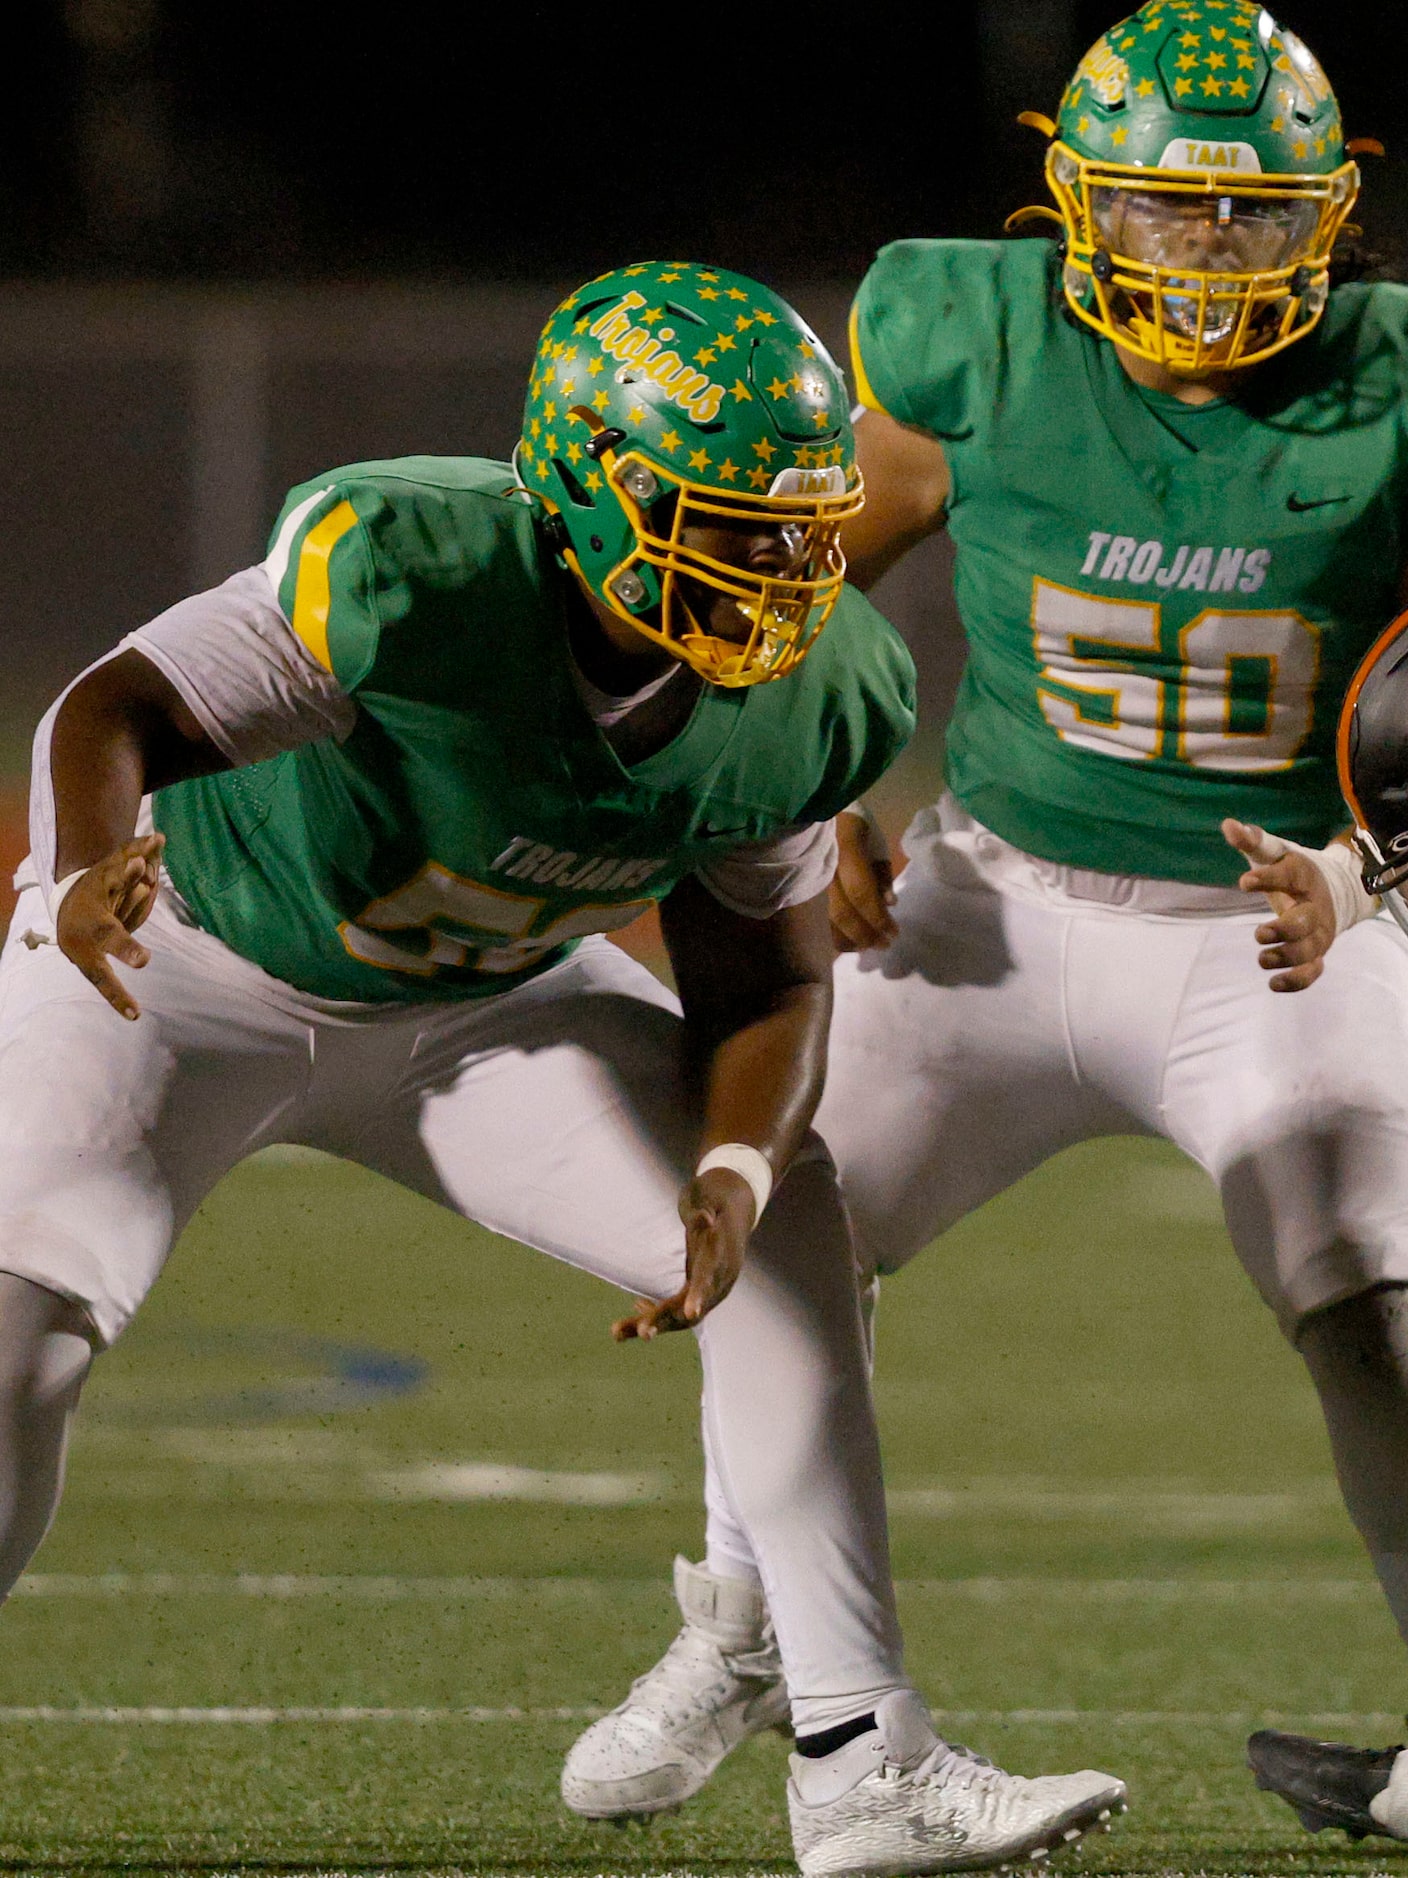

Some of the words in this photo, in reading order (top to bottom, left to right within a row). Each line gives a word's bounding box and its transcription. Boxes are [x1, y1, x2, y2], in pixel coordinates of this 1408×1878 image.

[590, 290, 727, 423] Trojans
[1080, 531, 1271, 594] TROJANS
[1031, 574, 1322, 773] 50
